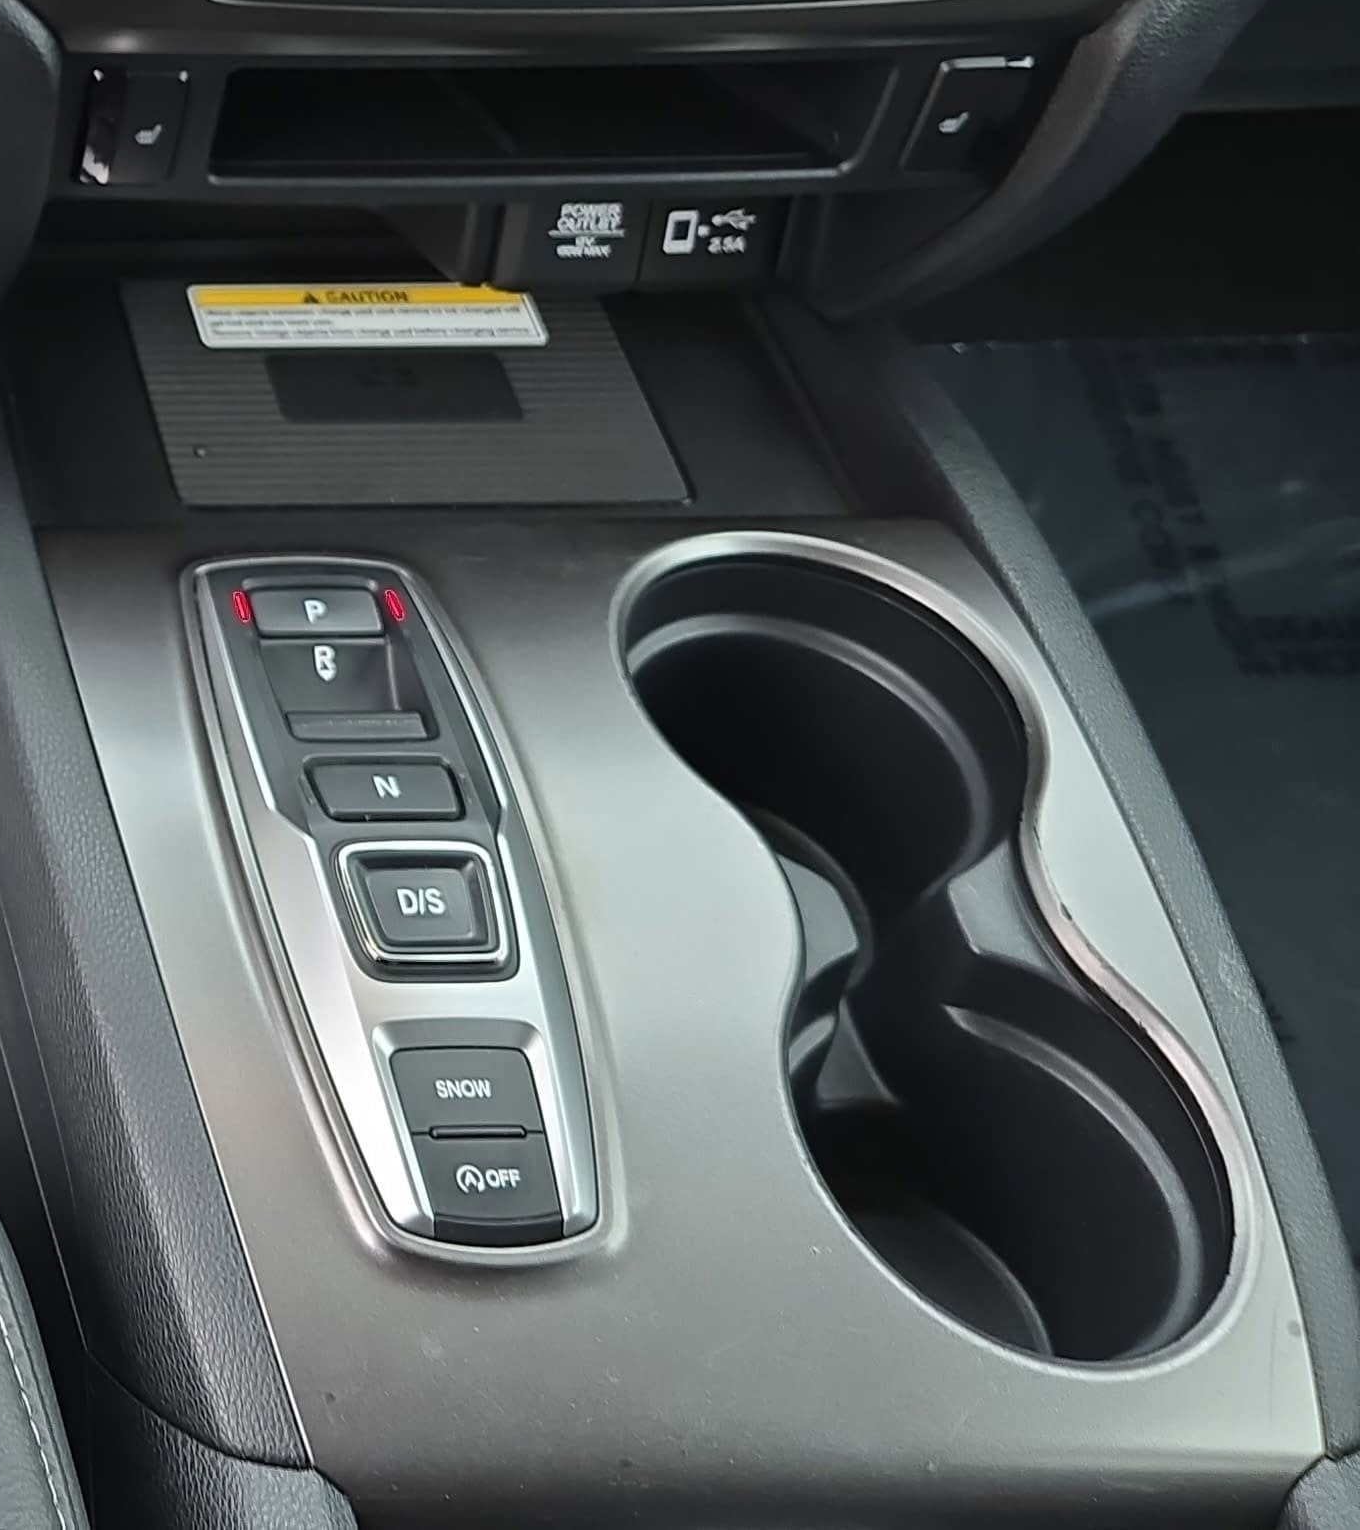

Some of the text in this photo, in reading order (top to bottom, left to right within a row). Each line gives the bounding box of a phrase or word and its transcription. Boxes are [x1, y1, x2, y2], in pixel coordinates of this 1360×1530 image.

[326, 290, 409, 304] CAUTION
[303, 599, 329, 624] P
[313, 645, 337, 672] R
[372, 775, 401, 799] N
[396, 887, 447, 916] D/S
[434, 1078, 492, 1099] SNOW
[486, 1168, 521, 1189] OFF
